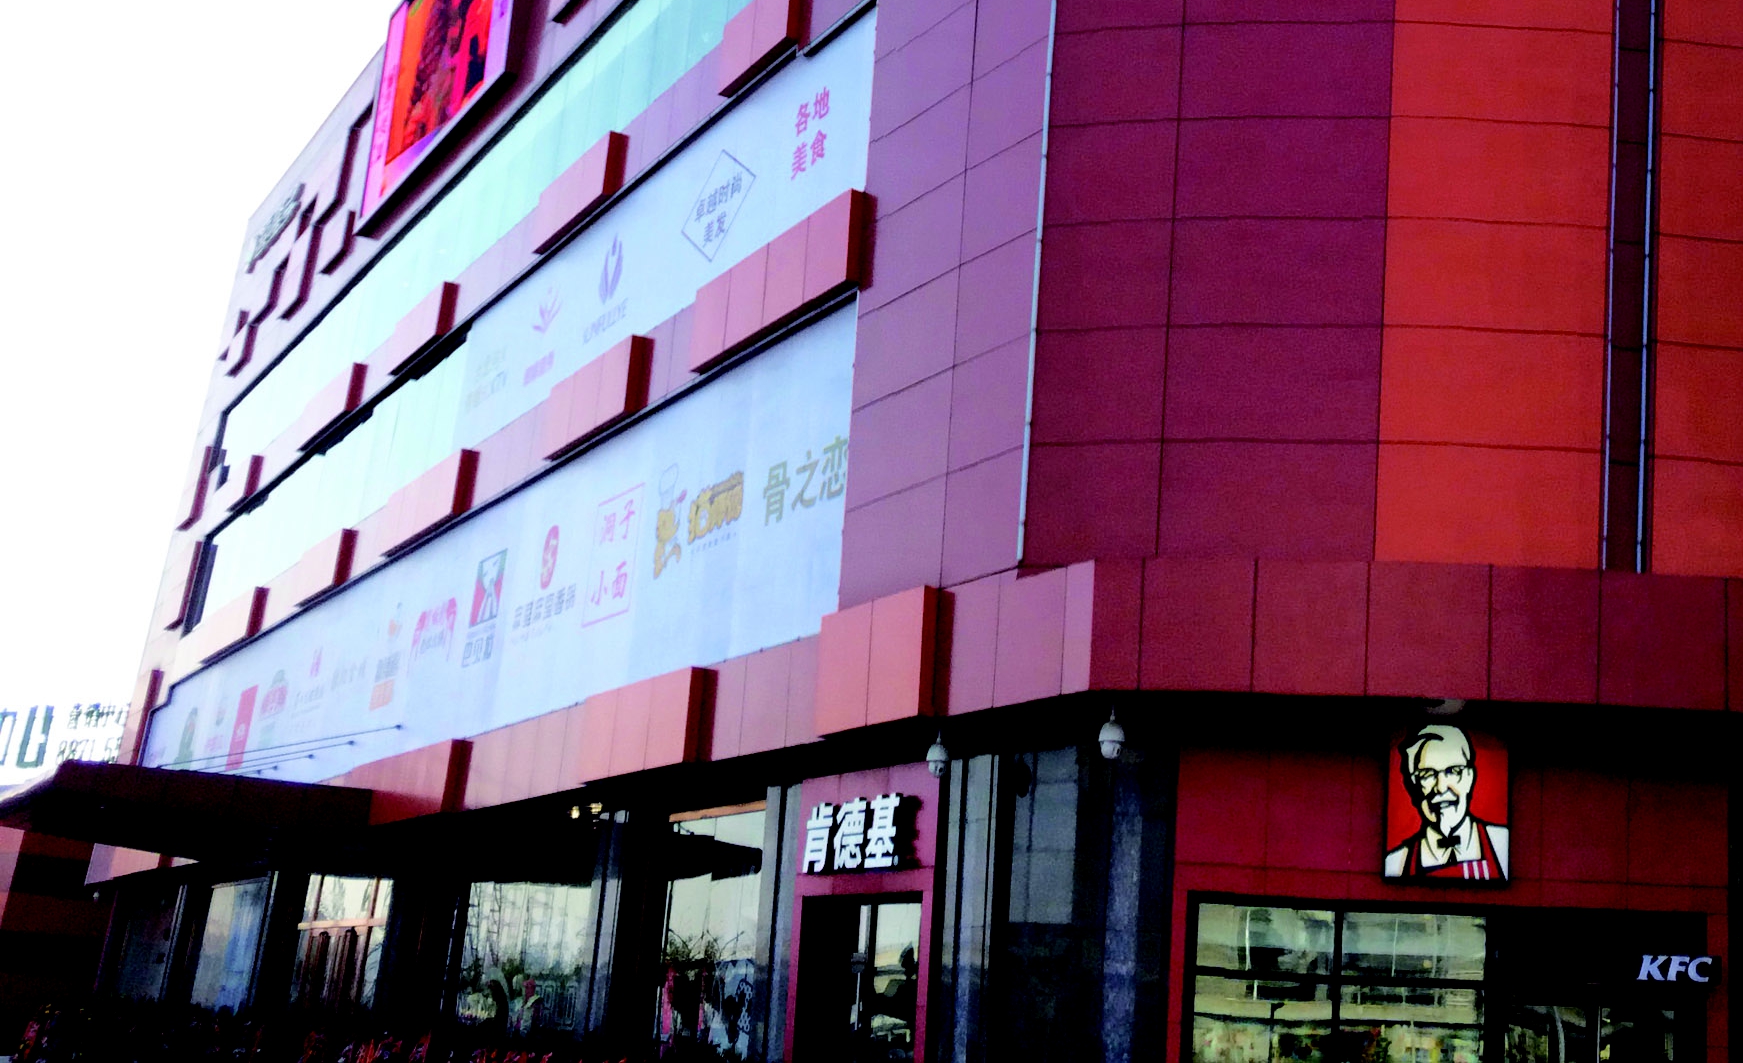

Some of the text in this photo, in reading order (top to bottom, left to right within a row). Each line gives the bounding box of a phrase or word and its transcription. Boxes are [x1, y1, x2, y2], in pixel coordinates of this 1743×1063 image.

[794, 86, 831, 138] 各地
[790, 129, 827, 180] 美食
[763, 434, 849, 527] 骨之恋
[802, 792, 901, 874] 肯德基
[1636, 955, 1712, 983] KFC
